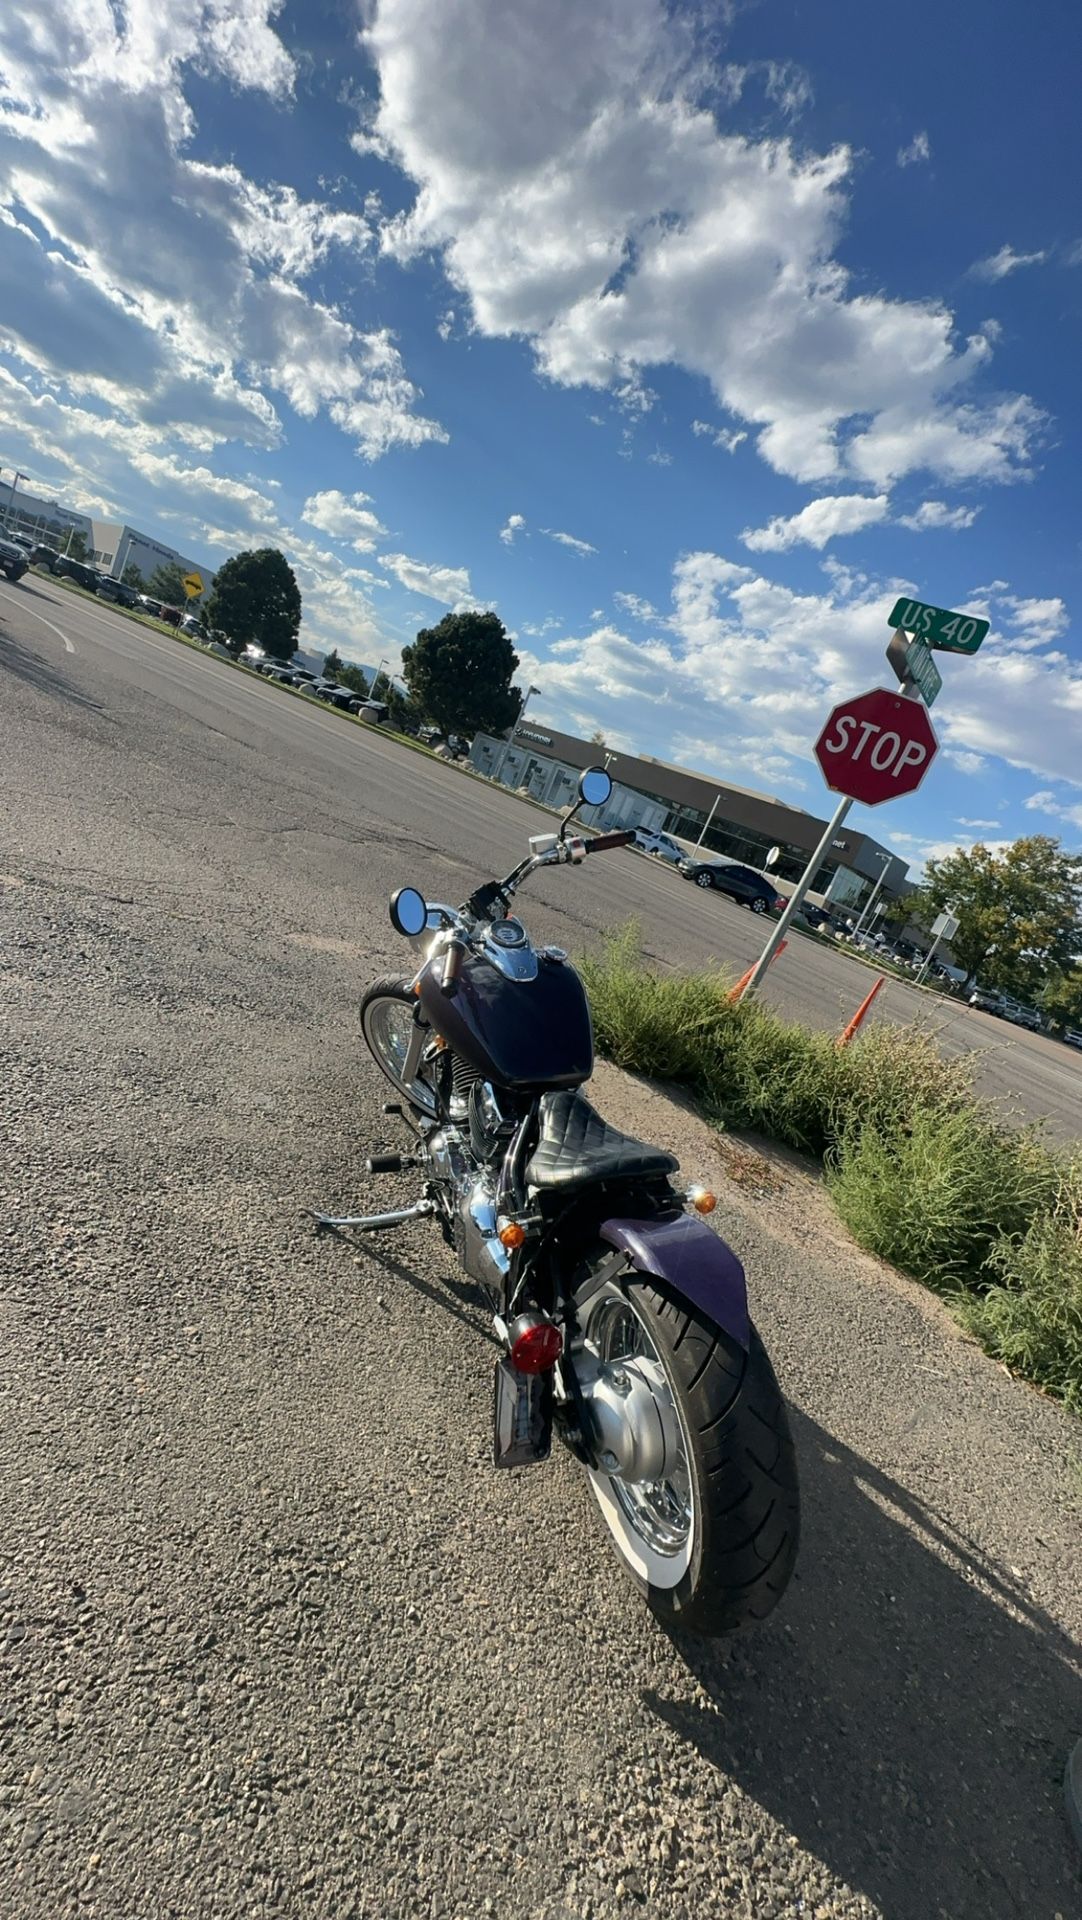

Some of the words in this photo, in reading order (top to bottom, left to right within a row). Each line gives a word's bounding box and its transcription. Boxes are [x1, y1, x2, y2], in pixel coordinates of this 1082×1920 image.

[901, 602, 937, 632] US
[939, 616, 978, 644] 40
[825, 715, 927, 778] STOP
